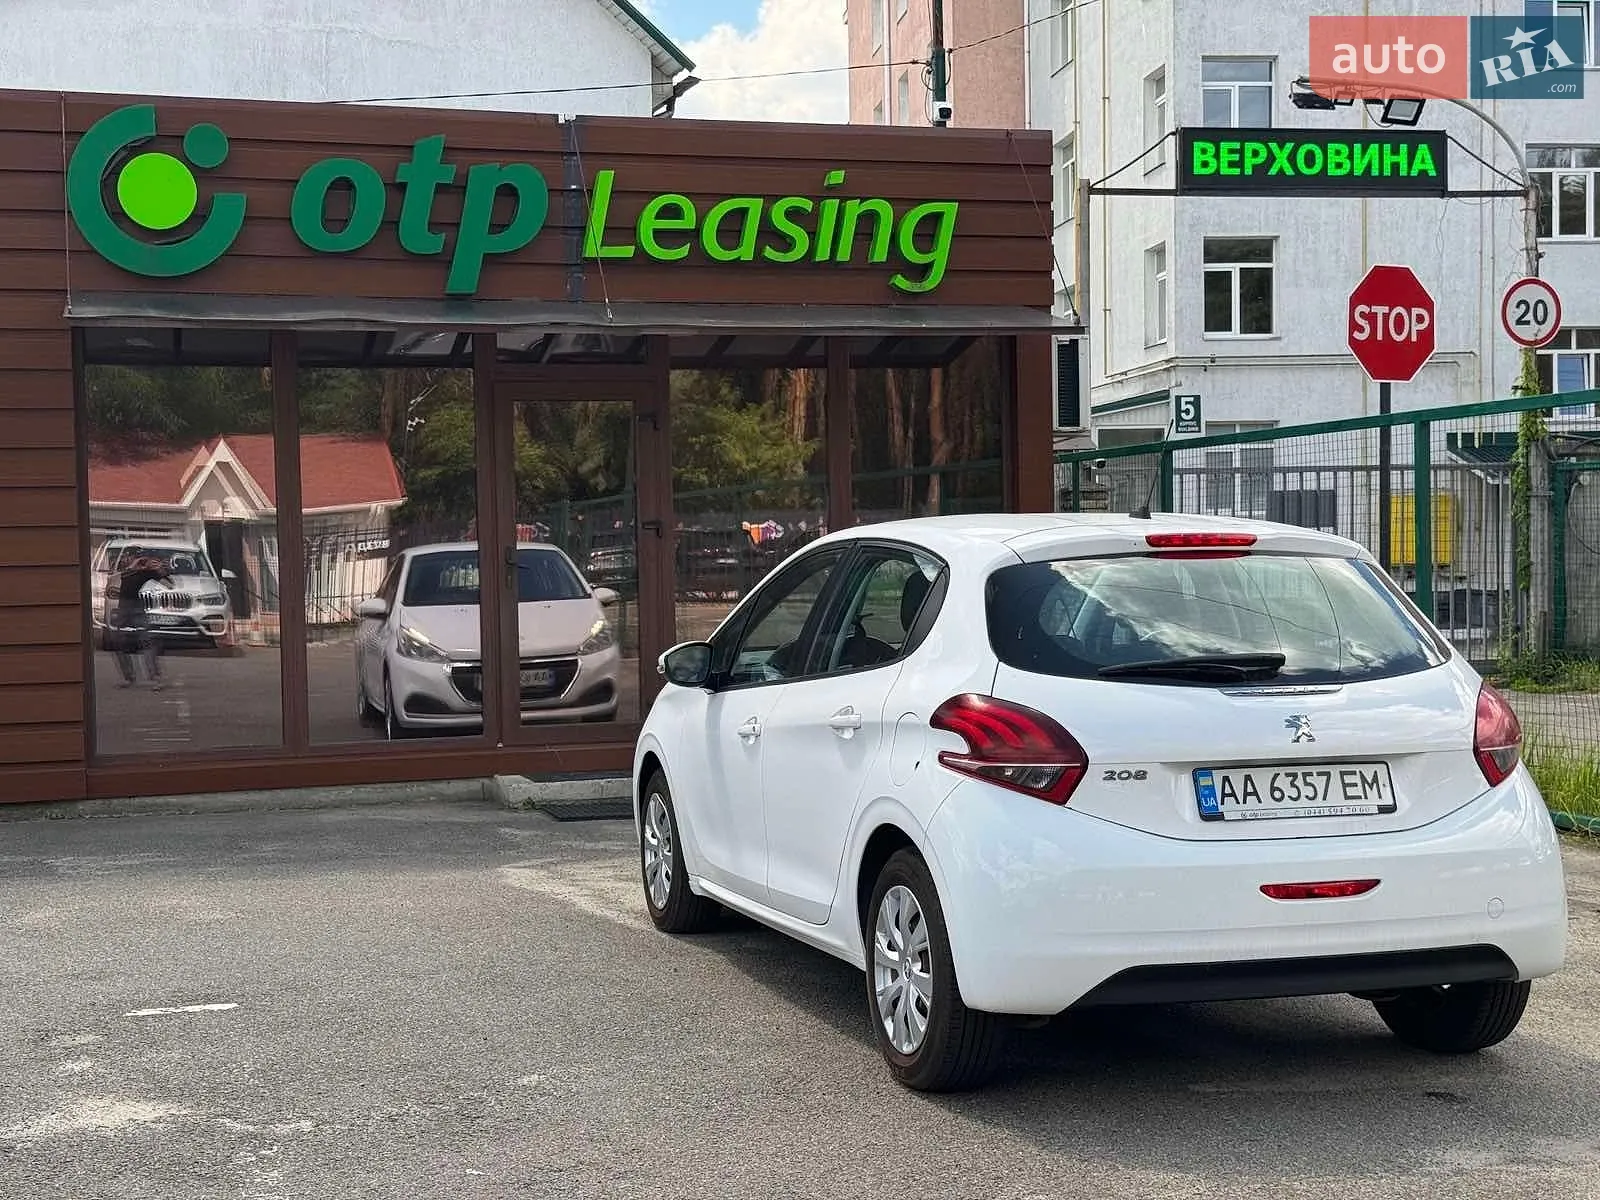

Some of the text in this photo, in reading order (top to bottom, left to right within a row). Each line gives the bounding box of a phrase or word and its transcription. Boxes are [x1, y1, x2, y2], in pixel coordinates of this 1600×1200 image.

[1192, 142, 1437, 177] ВЕРХОВИНА
[290, 134, 959, 294] otp Leasing
[1352, 304, 1430, 342] STOP
[1515, 299, 1549, 326] 20
[1180, 397, 1195, 420] 5
[1102, 769, 1149, 781] 208
[1220, 770, 1383, 806] AA 6357 EM
[1201, 797, 1217, 808] UA
